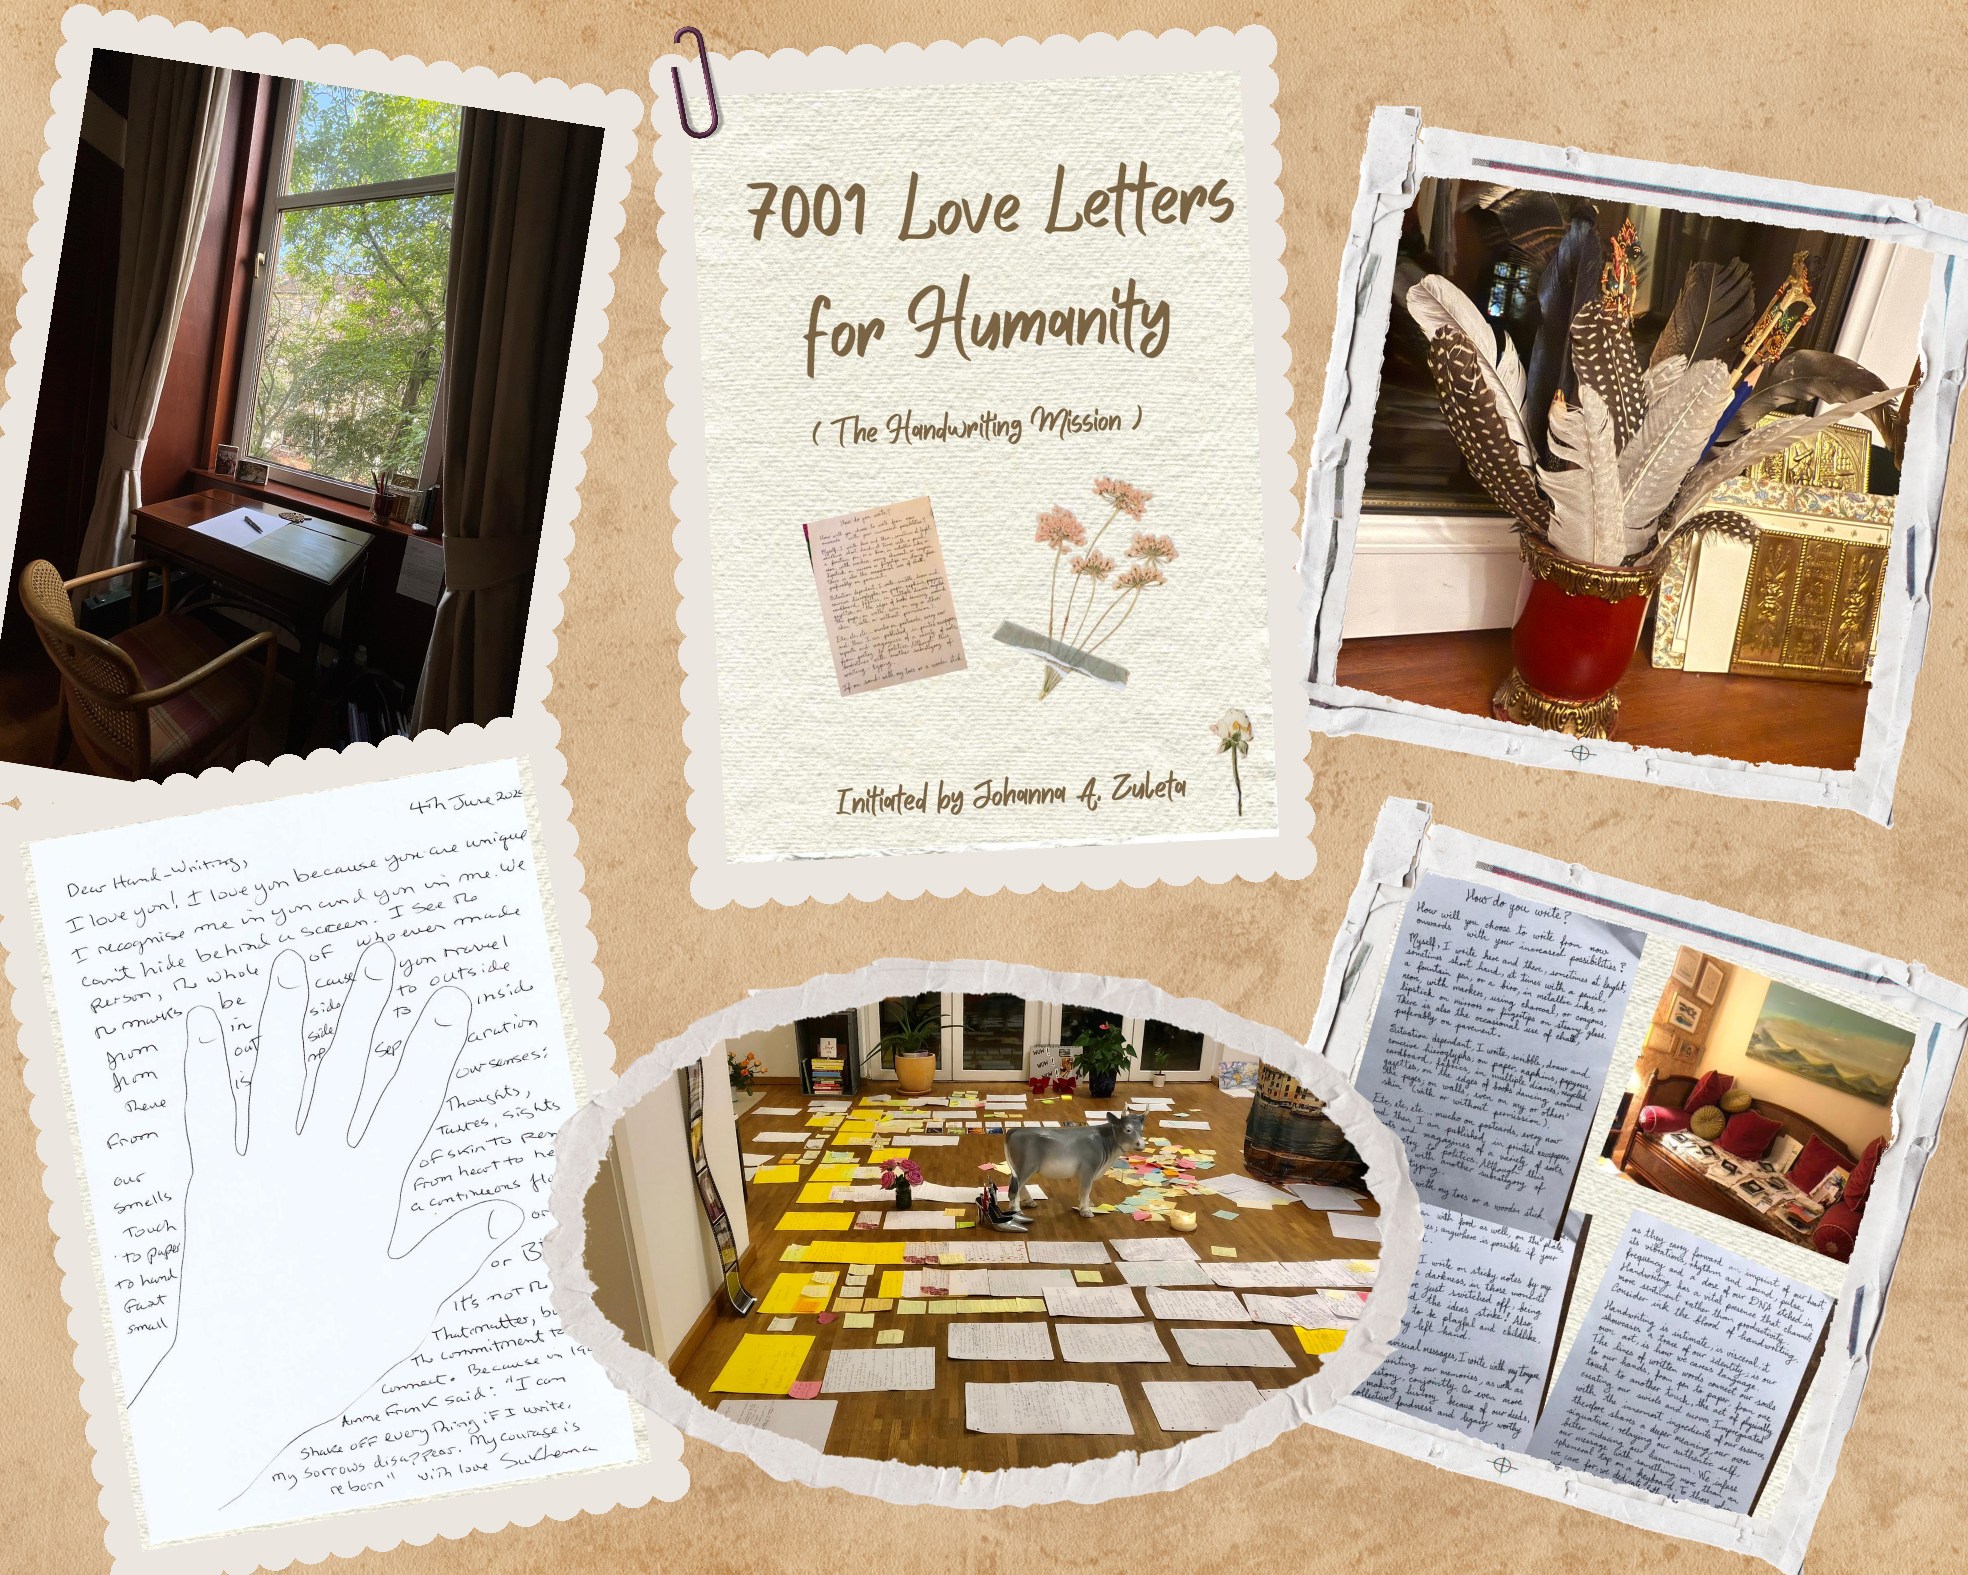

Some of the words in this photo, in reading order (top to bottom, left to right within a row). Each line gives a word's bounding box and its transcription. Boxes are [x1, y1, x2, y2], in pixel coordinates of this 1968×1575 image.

[747, 183, 865, 241] 7001
[898, 172, 1020, 241] Love
[1045, 161, 1234, 237] Letters
[803, 295, 885, 378] for
[908, 274, 1170, 361] Humanity
[831, 415, 877, 448] The
[886, 409, 1022, 445] Handwriting
[1031, 406, 1121, 440] Mission
[448, 794, 494, 810] June
[837, 782, 928, 816] Initiated
[937, 780, 963, 815] by
[973, 777, 1066, 808] Johanna
[1112, 770, 1186, 801] Zuleta
[66, 916, 84, 934] I
[89, 911, 127, 927] love
[187, 890, 201, 907] I
[210, 886, 248, 902] love
[292, 859, 377, 883] because
[429, 844, 457, 855] are
[466, 830, 527, 850] unique
[67, 882, 106, 898] Dear
[1465, 888, 1492, 905] How
[1492, 893, 1507, 908] do
[1508, 903, 1530, 919] you
[71, 946, 88, 964] I
[98, 930, 185, 955] recognise
[194, 921, 234, 933] me
[318, 888, 365, 908] and
[139, 954, 185, 977] hide
[195, 933, 271, 963] behind
[300, 919, 377, 936] screen.
[388, 904, 403, 920] I
[1416, 901, 1438, 915] How
[1440, 909, 1461, 921] will
[1463, 919, 1479, 932] you
[1532, 929, 1554, 942] write
[1559, 934, 1582, 950] from
[206, 964, 259, 983] whole
[454, 905, 520, 925] made
[1501, 956, 1520, 967] and
[217, 991, 245, 1009] be
[230, 1017, 252, 1032] in
[430, 961, 510, 987] outside
[307, 1023, 335, 1042] side
[1673, 1307, 1690, 1320] the
[440, 1329, 545, 1360] commitment
[467, 1357, 540, 1377] Because
[564, 1421, 580, 1432] is
[459, 1463, 488, 1473] love
